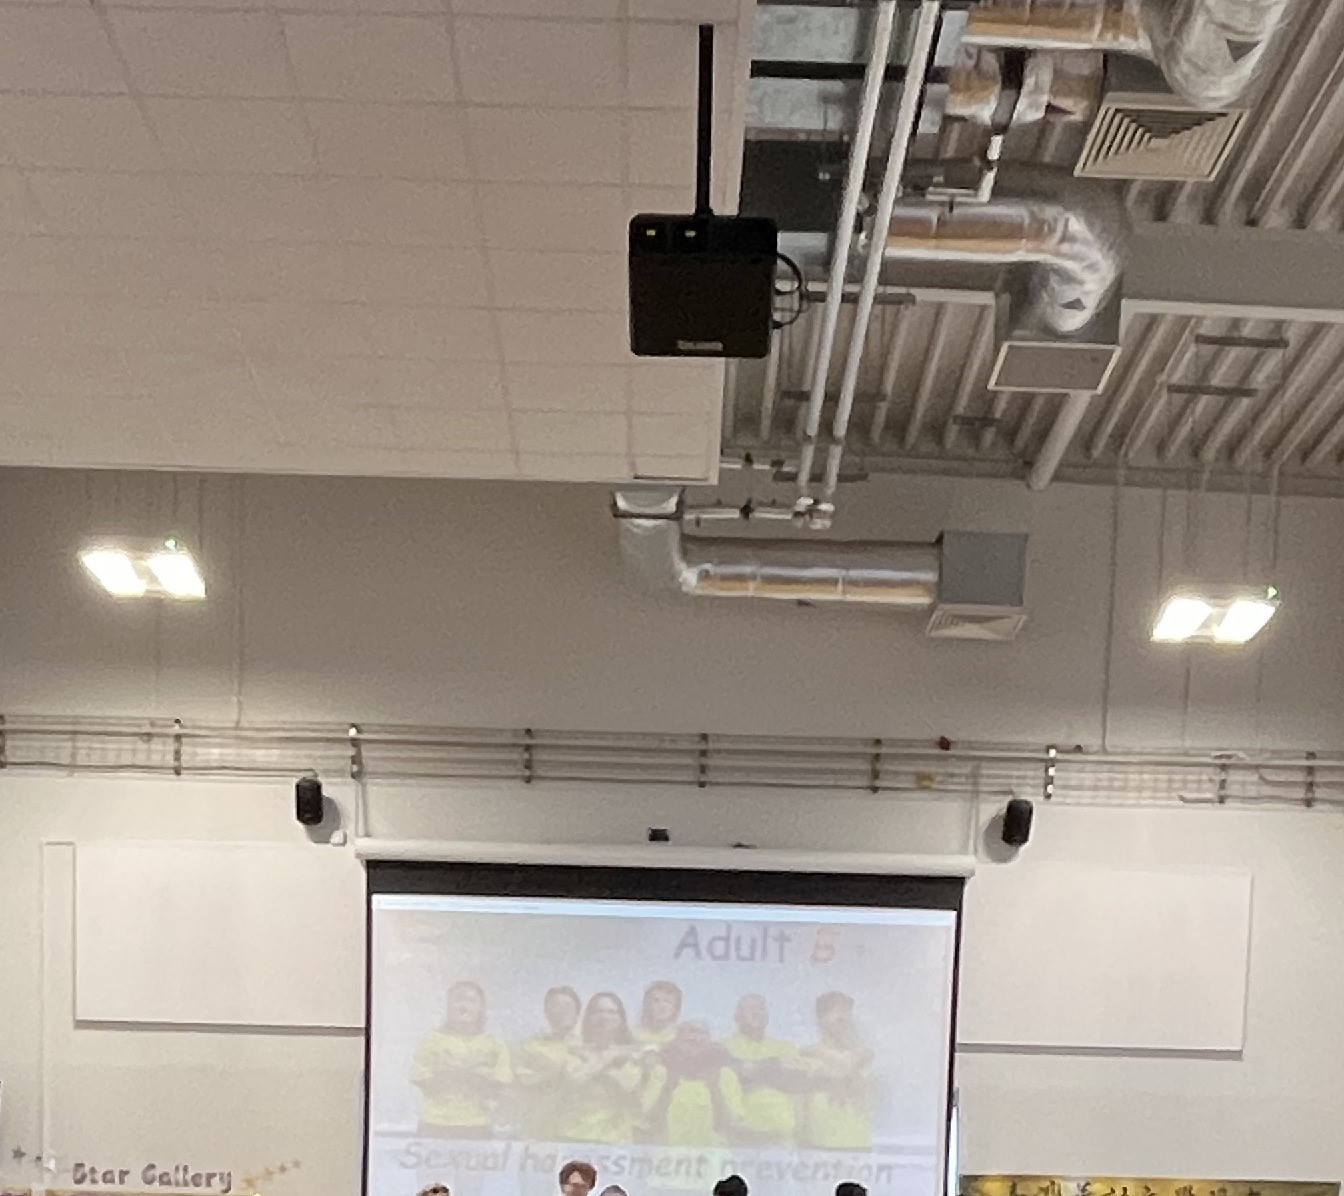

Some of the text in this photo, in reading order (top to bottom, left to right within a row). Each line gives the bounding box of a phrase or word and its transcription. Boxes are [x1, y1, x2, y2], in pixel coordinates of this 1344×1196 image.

[674, 924, 793, 963] Adult
[72, 1163, 233, 1193] Star Gallery
